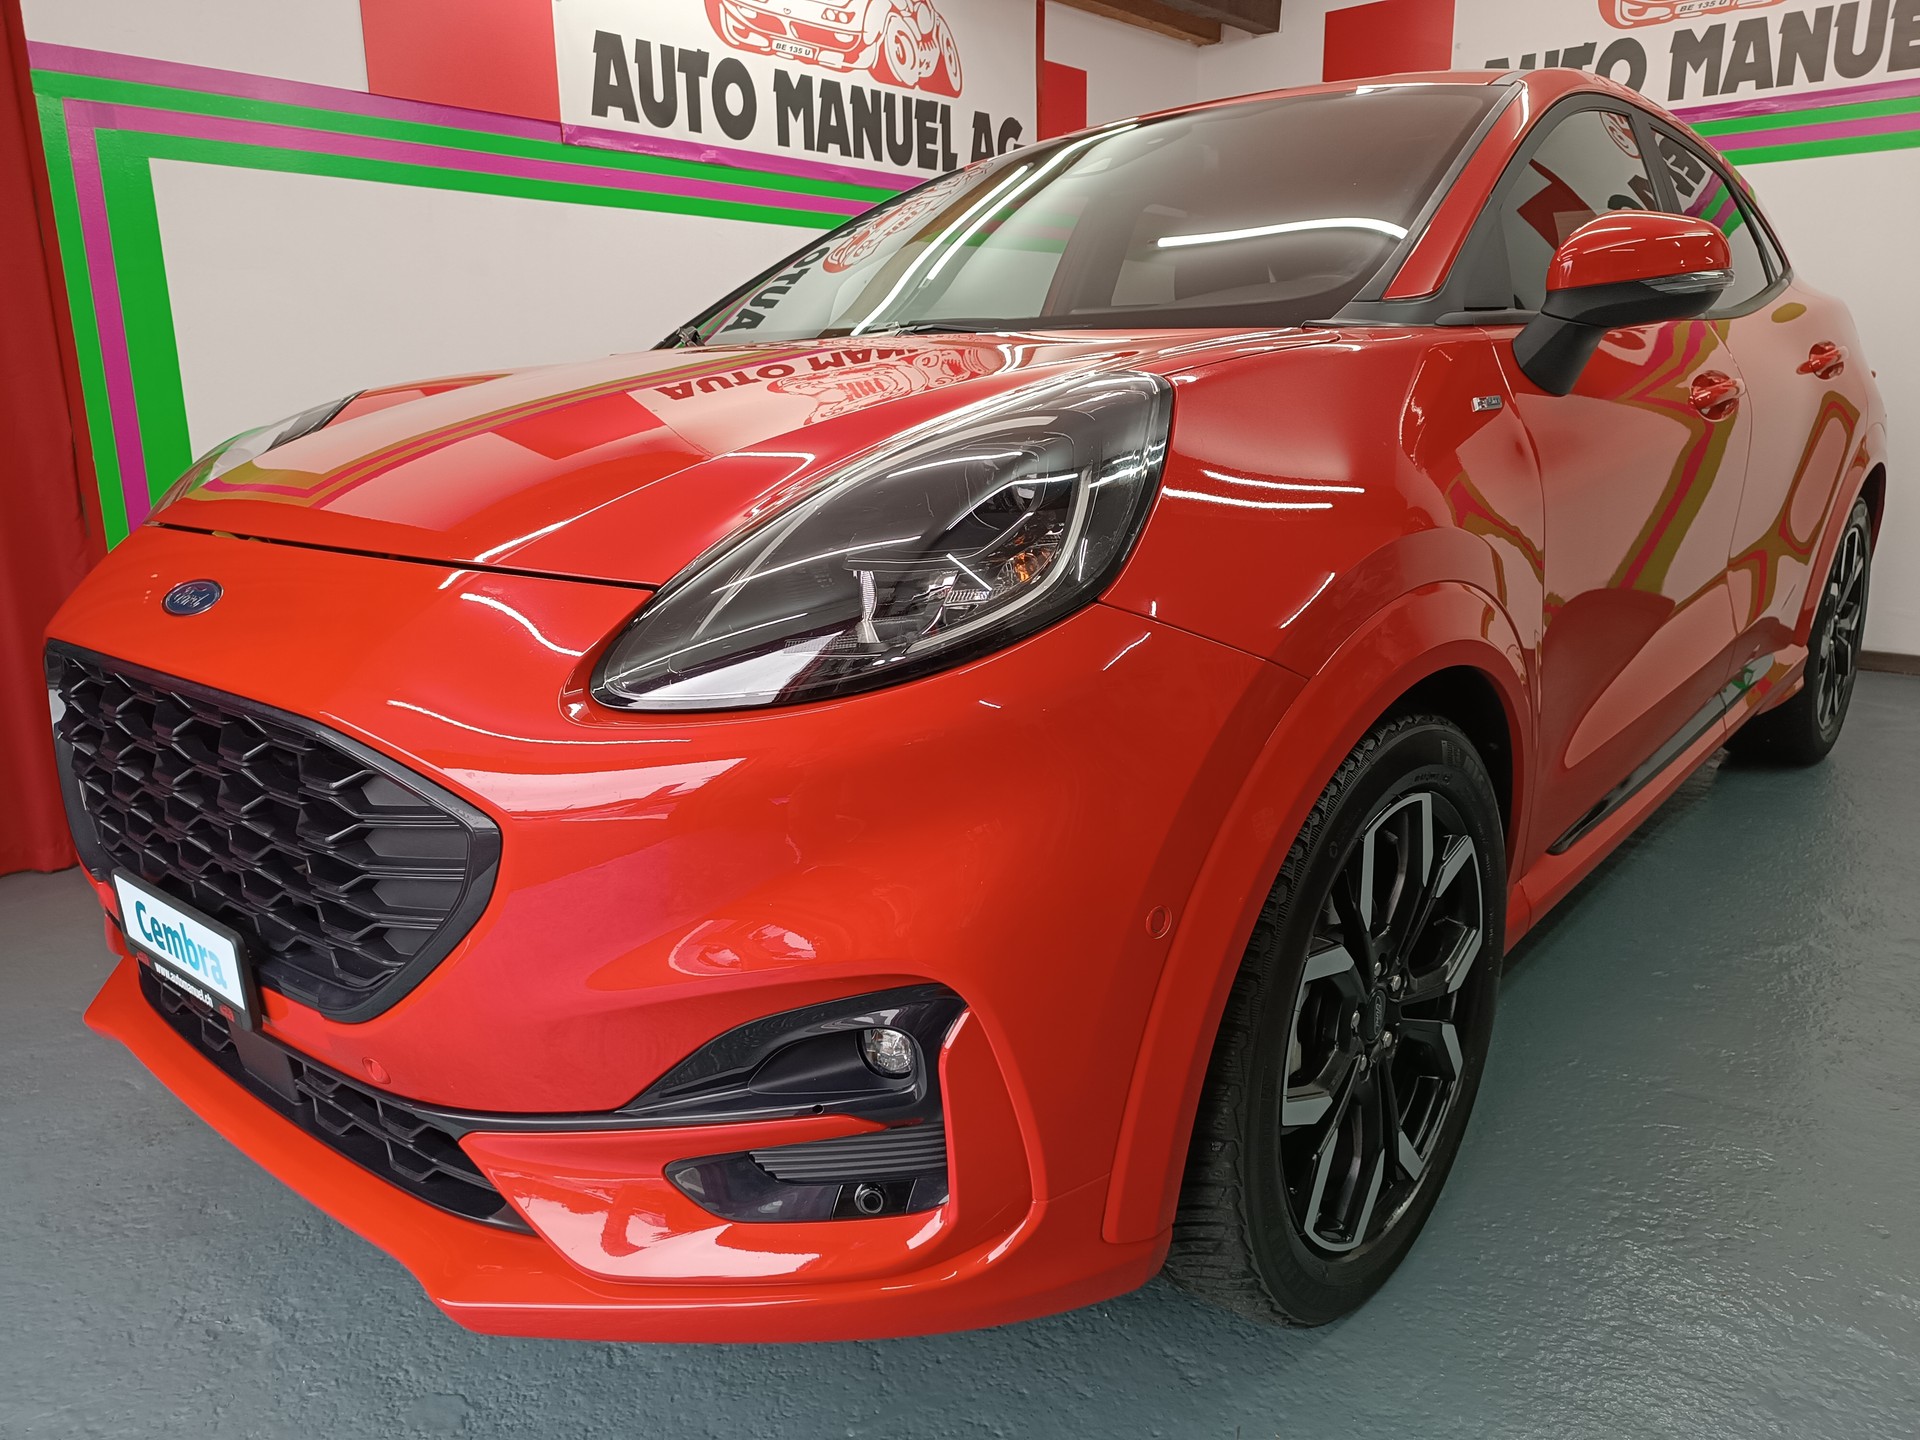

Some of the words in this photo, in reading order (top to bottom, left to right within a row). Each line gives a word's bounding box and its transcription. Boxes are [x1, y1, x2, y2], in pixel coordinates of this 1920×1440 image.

[775, 42, 787, 51] BE
[789, 45, 803, 55] 135
[804, 48, 811, 56] U
[591, 29, 758, 141] AUTO
[772, 68, 959, 173] MANUEL
[970, 110, 1027, 164] AG
[135, 900, 228, 990] Cembra
